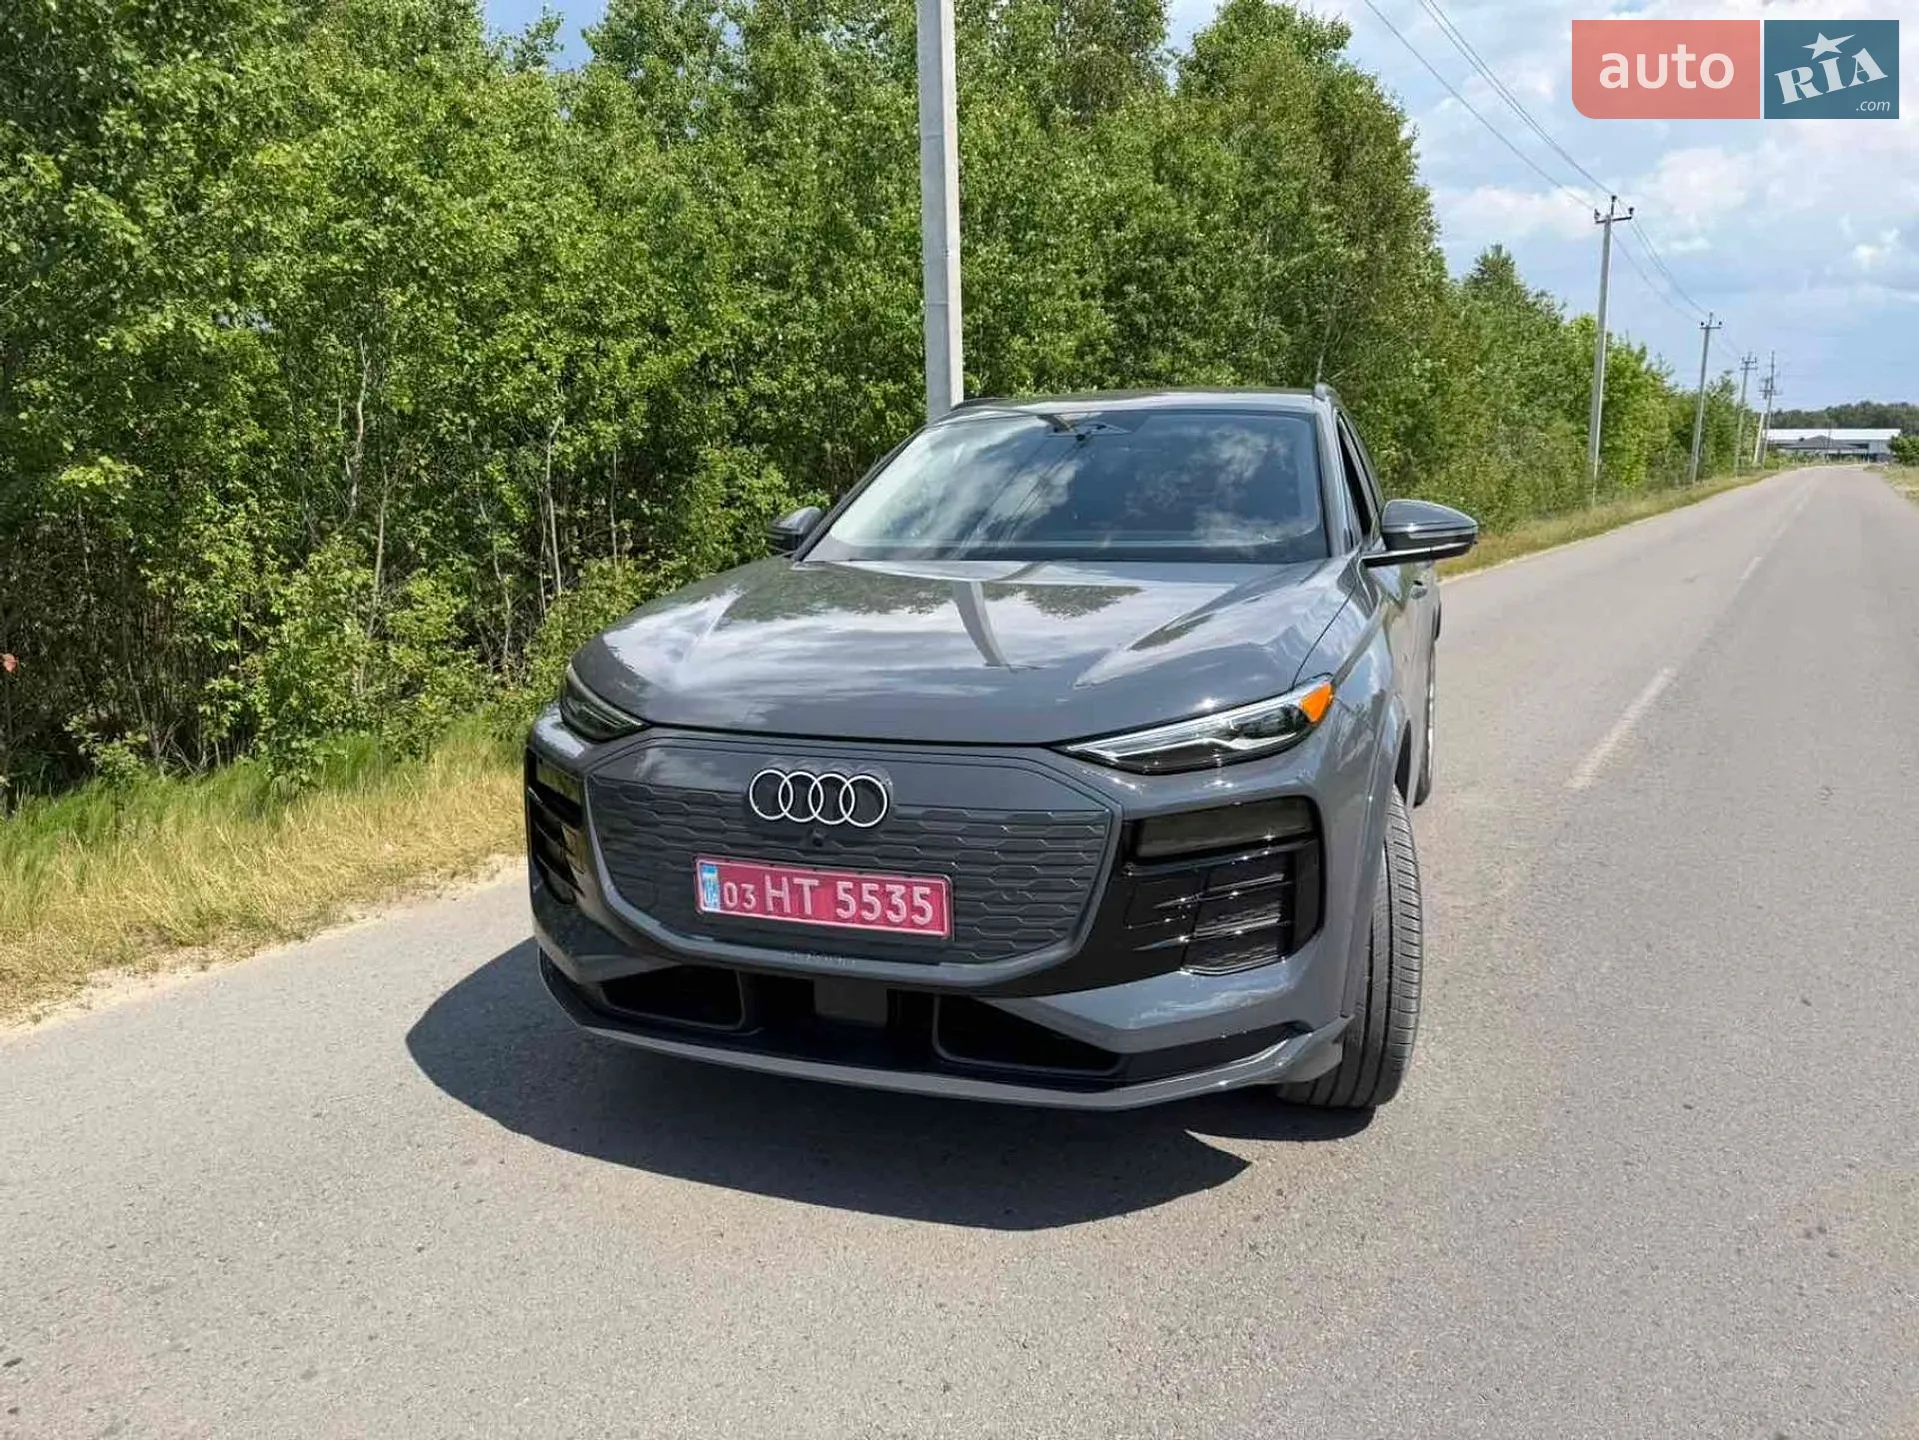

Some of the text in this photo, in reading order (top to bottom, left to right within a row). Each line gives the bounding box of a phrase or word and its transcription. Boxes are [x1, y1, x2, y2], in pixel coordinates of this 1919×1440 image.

[723, 882, 757, 910] 03
[764, 874, 820, 916] HT
[835, 880, 934, 926] 5535
